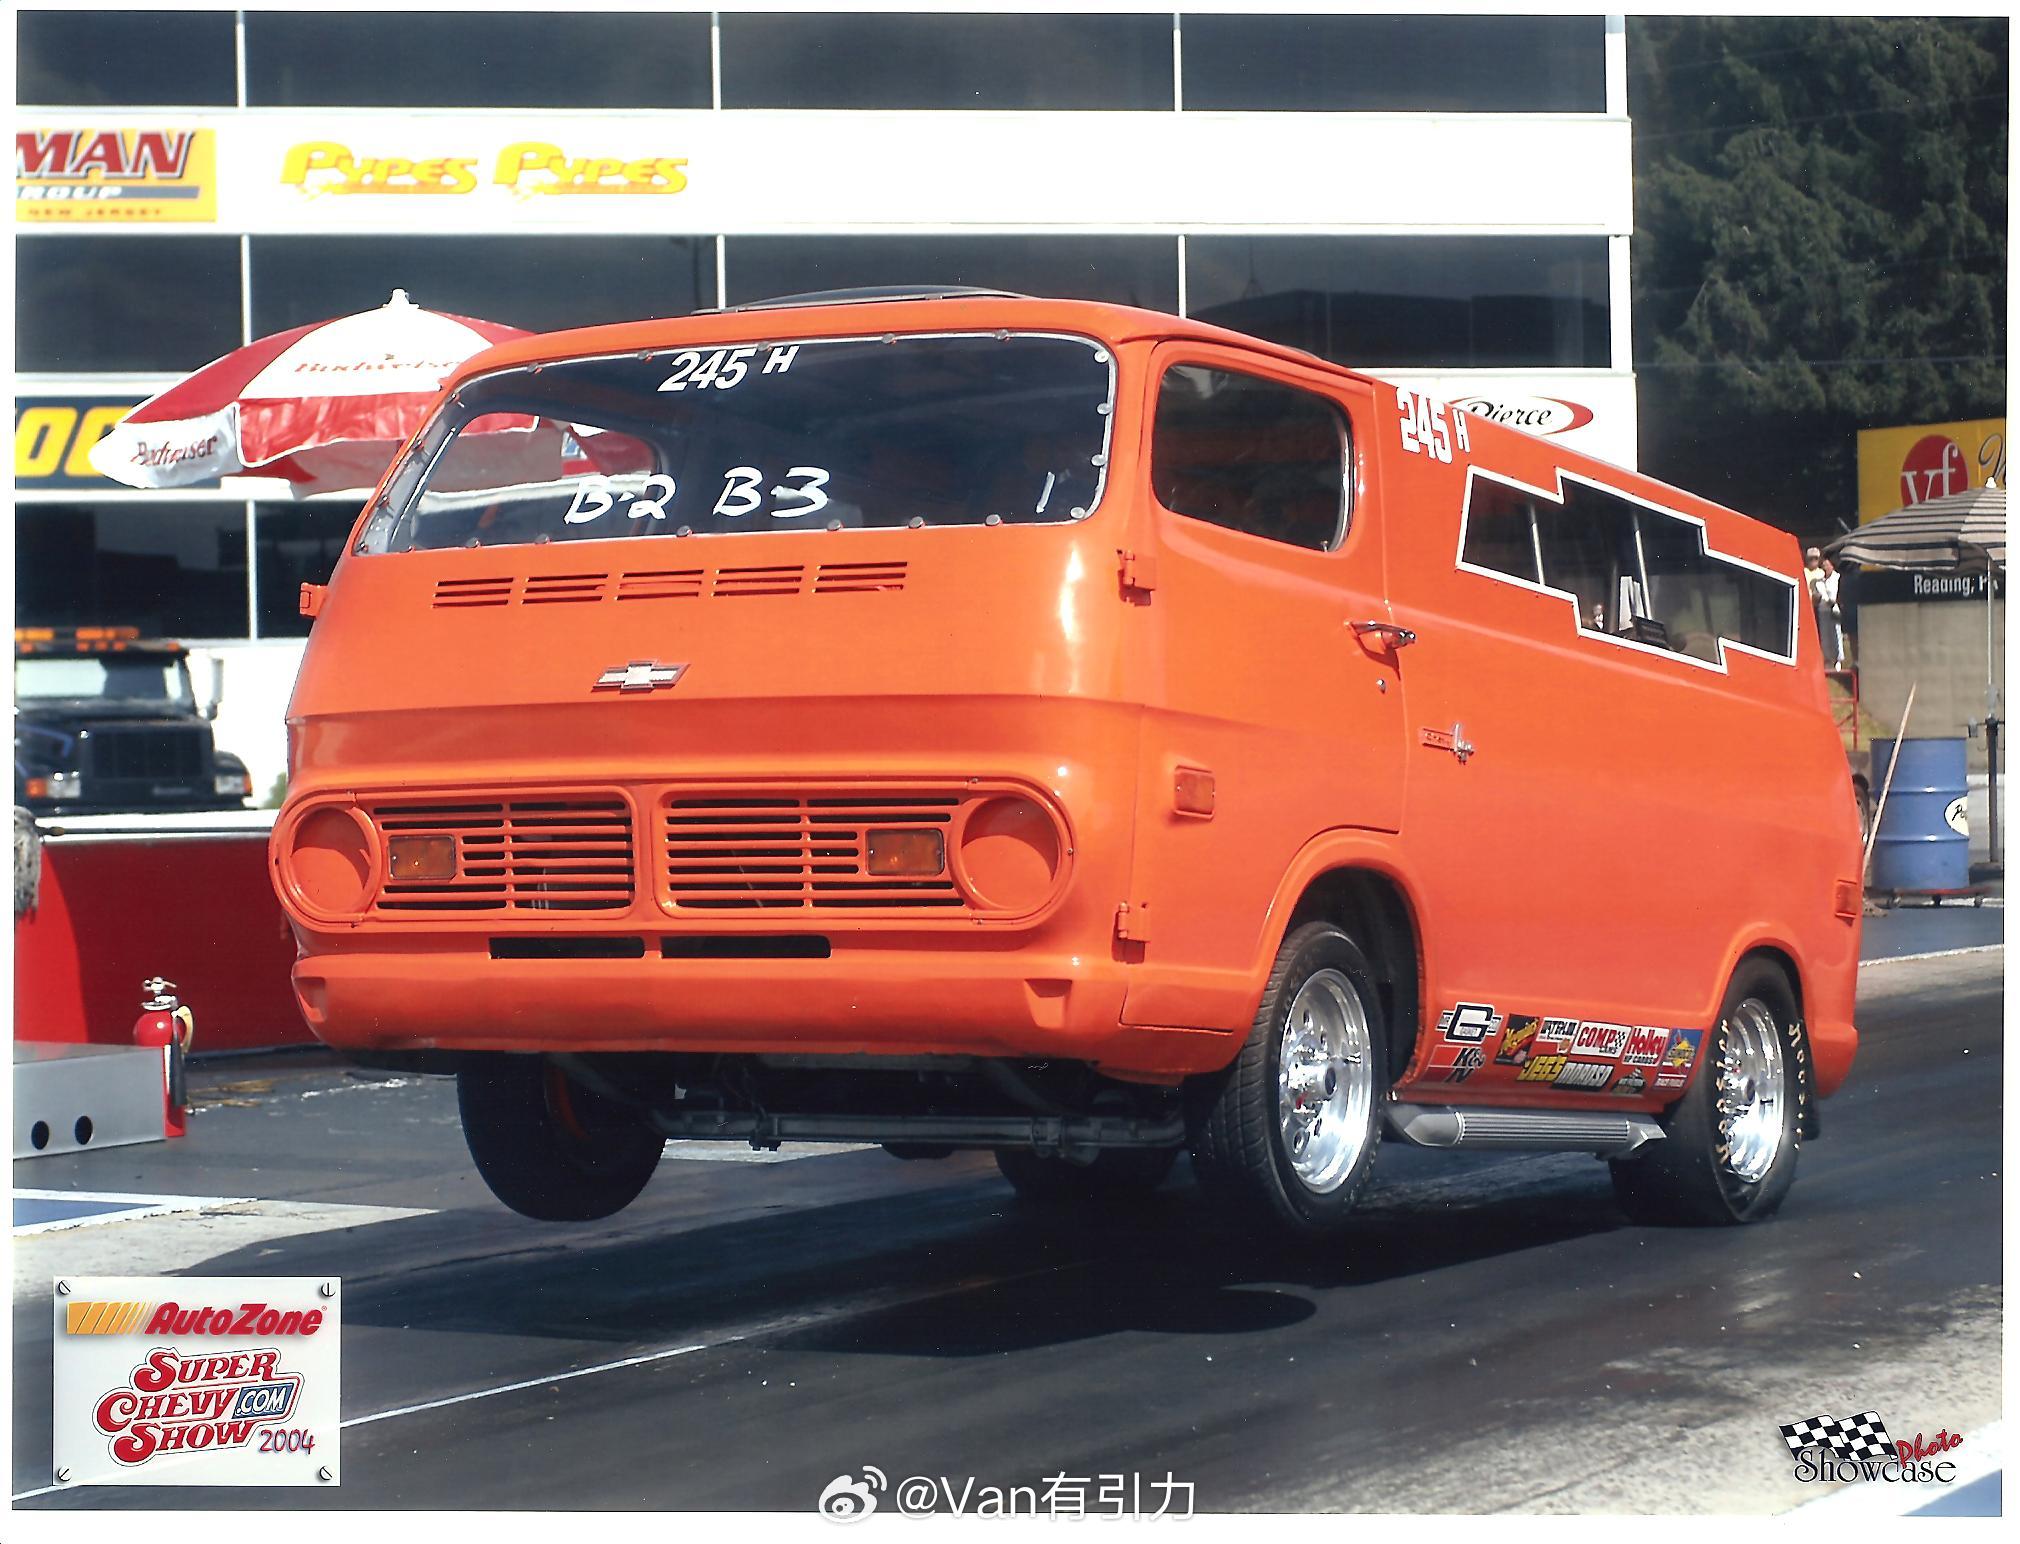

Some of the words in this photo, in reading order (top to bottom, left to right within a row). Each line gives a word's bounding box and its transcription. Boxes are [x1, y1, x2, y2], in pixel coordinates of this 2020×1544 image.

[657, 350, 755, 393] 245
[762, 345, 800, 374] H
[1396, 384, 1452, 464] 245
[1452, 408, 1470, 453] H
[1467, 400, 1552, 426] Pierce
[564, 474, 676, 523] B-2
[712, 467, 830, 518] B-3
[1576, 1026, 1617, 1048] COMP
[1626, 1028, 1666, 1056] Holley
